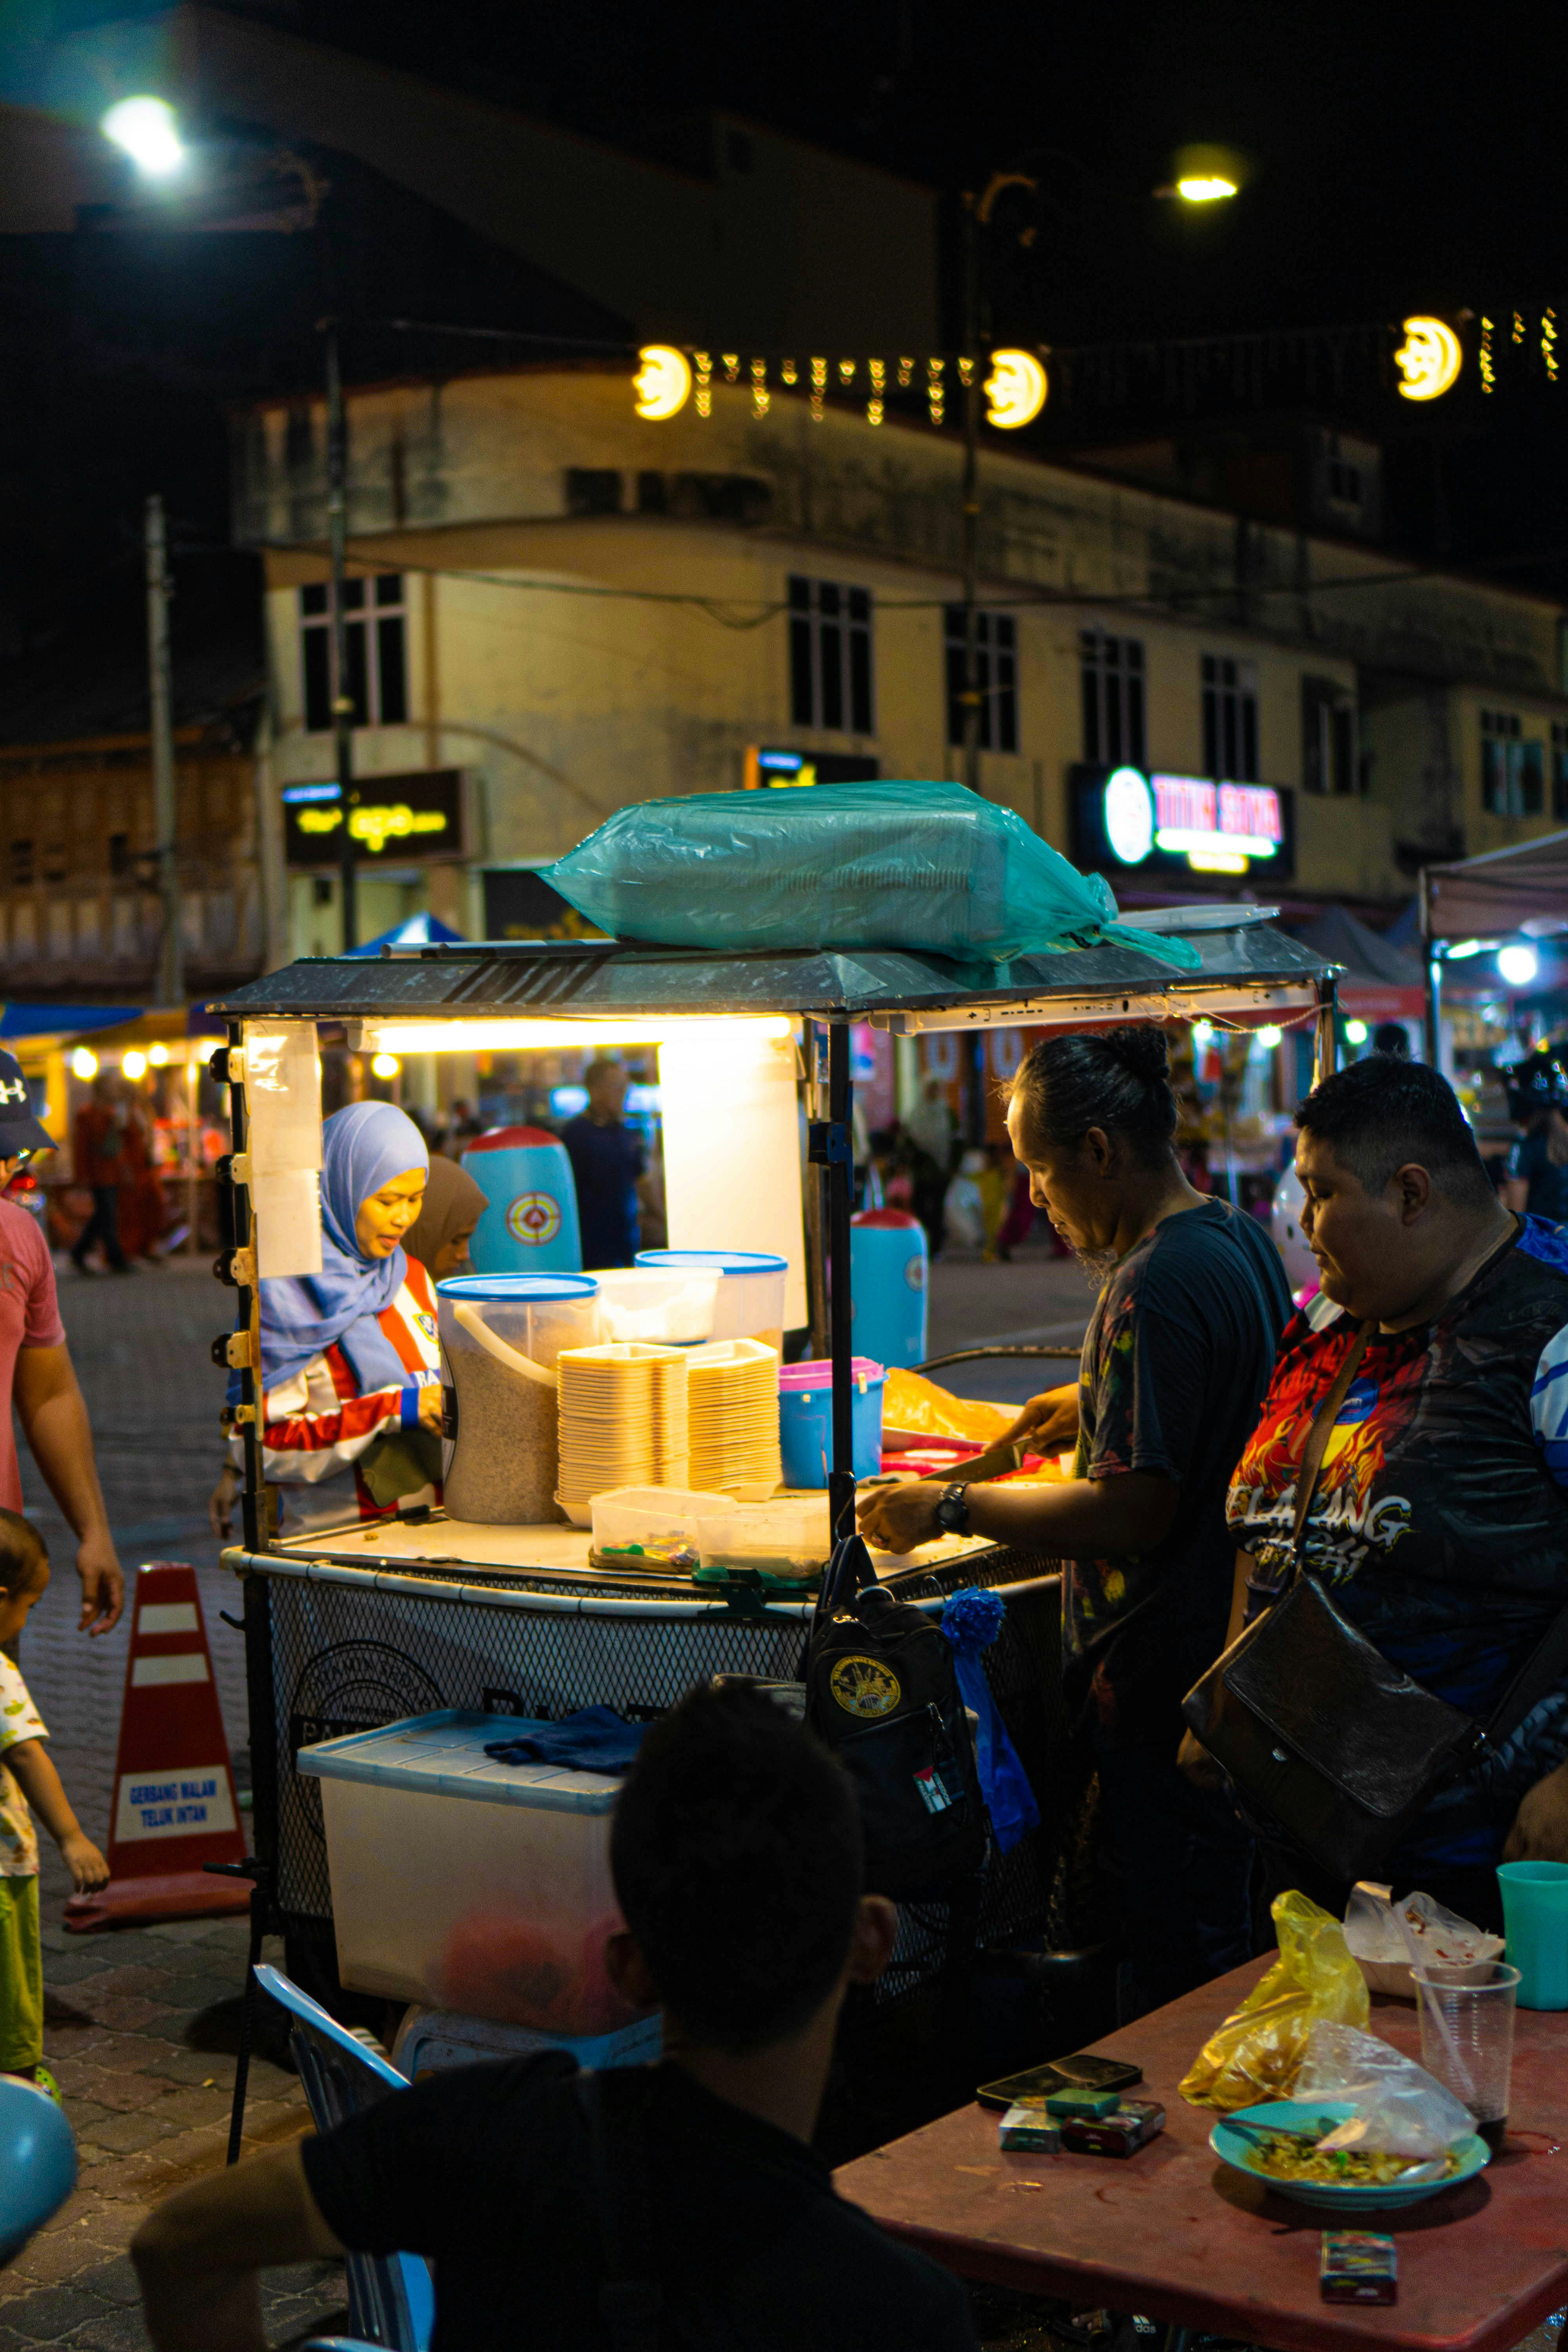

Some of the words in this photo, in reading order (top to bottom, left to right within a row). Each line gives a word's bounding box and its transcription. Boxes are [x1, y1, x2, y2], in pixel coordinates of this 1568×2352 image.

[130, 1783, 178, 1805] GERBANG
[180, 1779, 217, 1799] MALAM
[917, 1781, 936, 1814] PALESTINE
[141, 1807, 173, 1828] TELUK
[177, 1804, 207, 1823] INTAN
